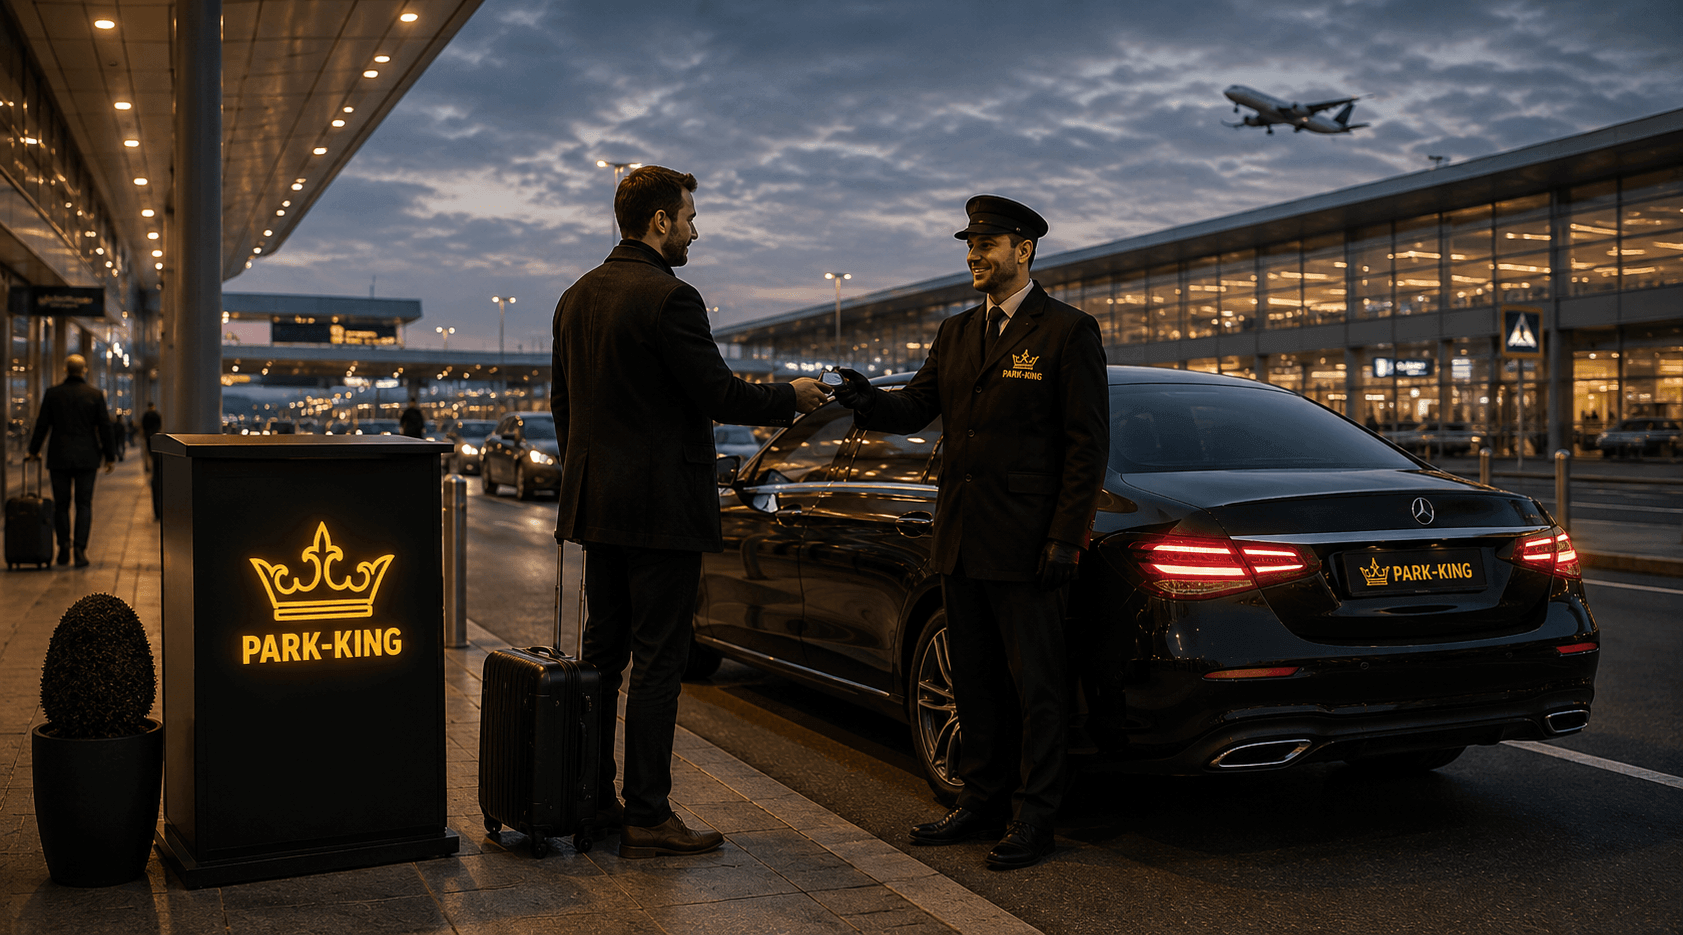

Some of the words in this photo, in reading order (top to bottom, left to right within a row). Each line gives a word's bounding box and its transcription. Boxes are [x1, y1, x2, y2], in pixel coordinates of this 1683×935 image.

[1002, 369, 1043, 381] PARK-KING
[1392, 562, 1473, 582] PARK-KING
[242, 627, 402, 665] PARK-KING
